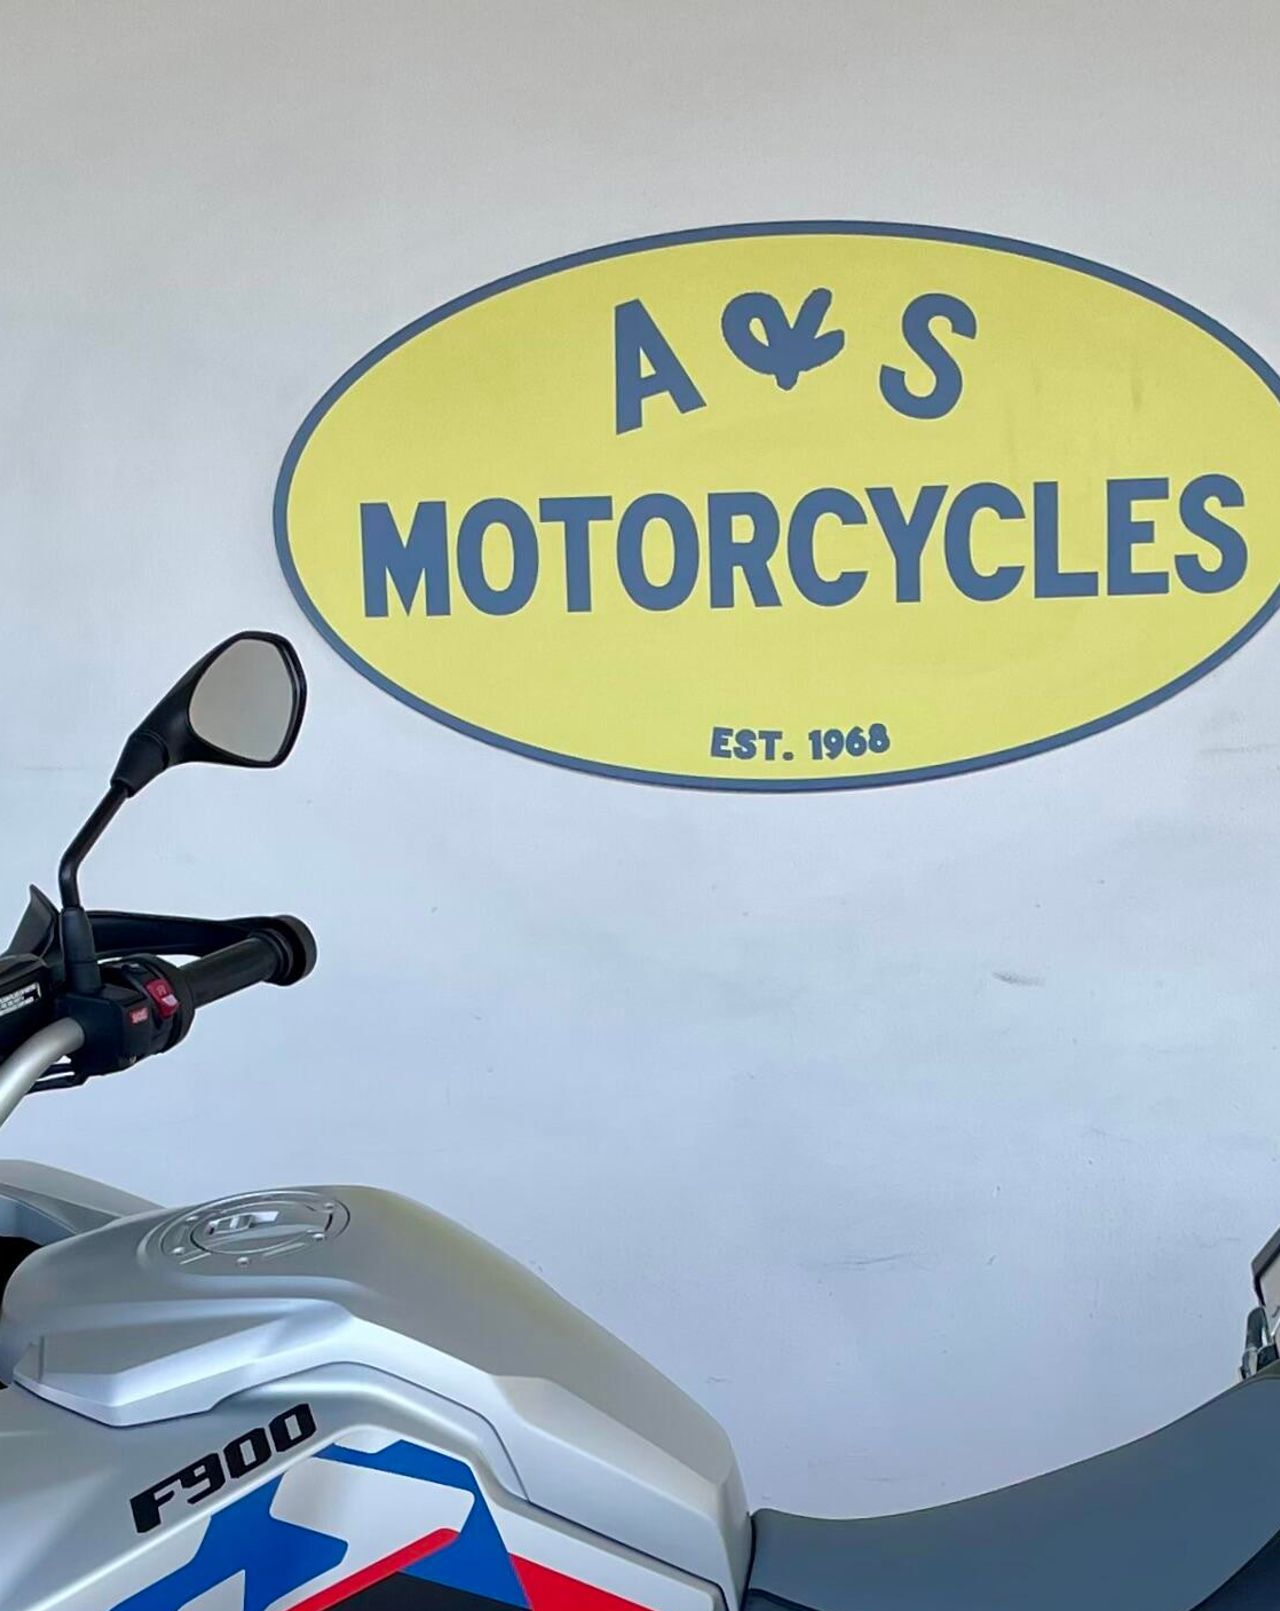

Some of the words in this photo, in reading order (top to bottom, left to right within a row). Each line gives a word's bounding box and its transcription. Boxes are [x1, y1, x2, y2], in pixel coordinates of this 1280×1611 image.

[613, 297, 708, 435] A
[878, 292, 977, 420] S
[358, 473, 1250, 618] MOTORCYCLES
[710, 726, 795, 761] EST.
[808, 722, 891, 760] 1968
[129, 1402, 318, 1534] F900
